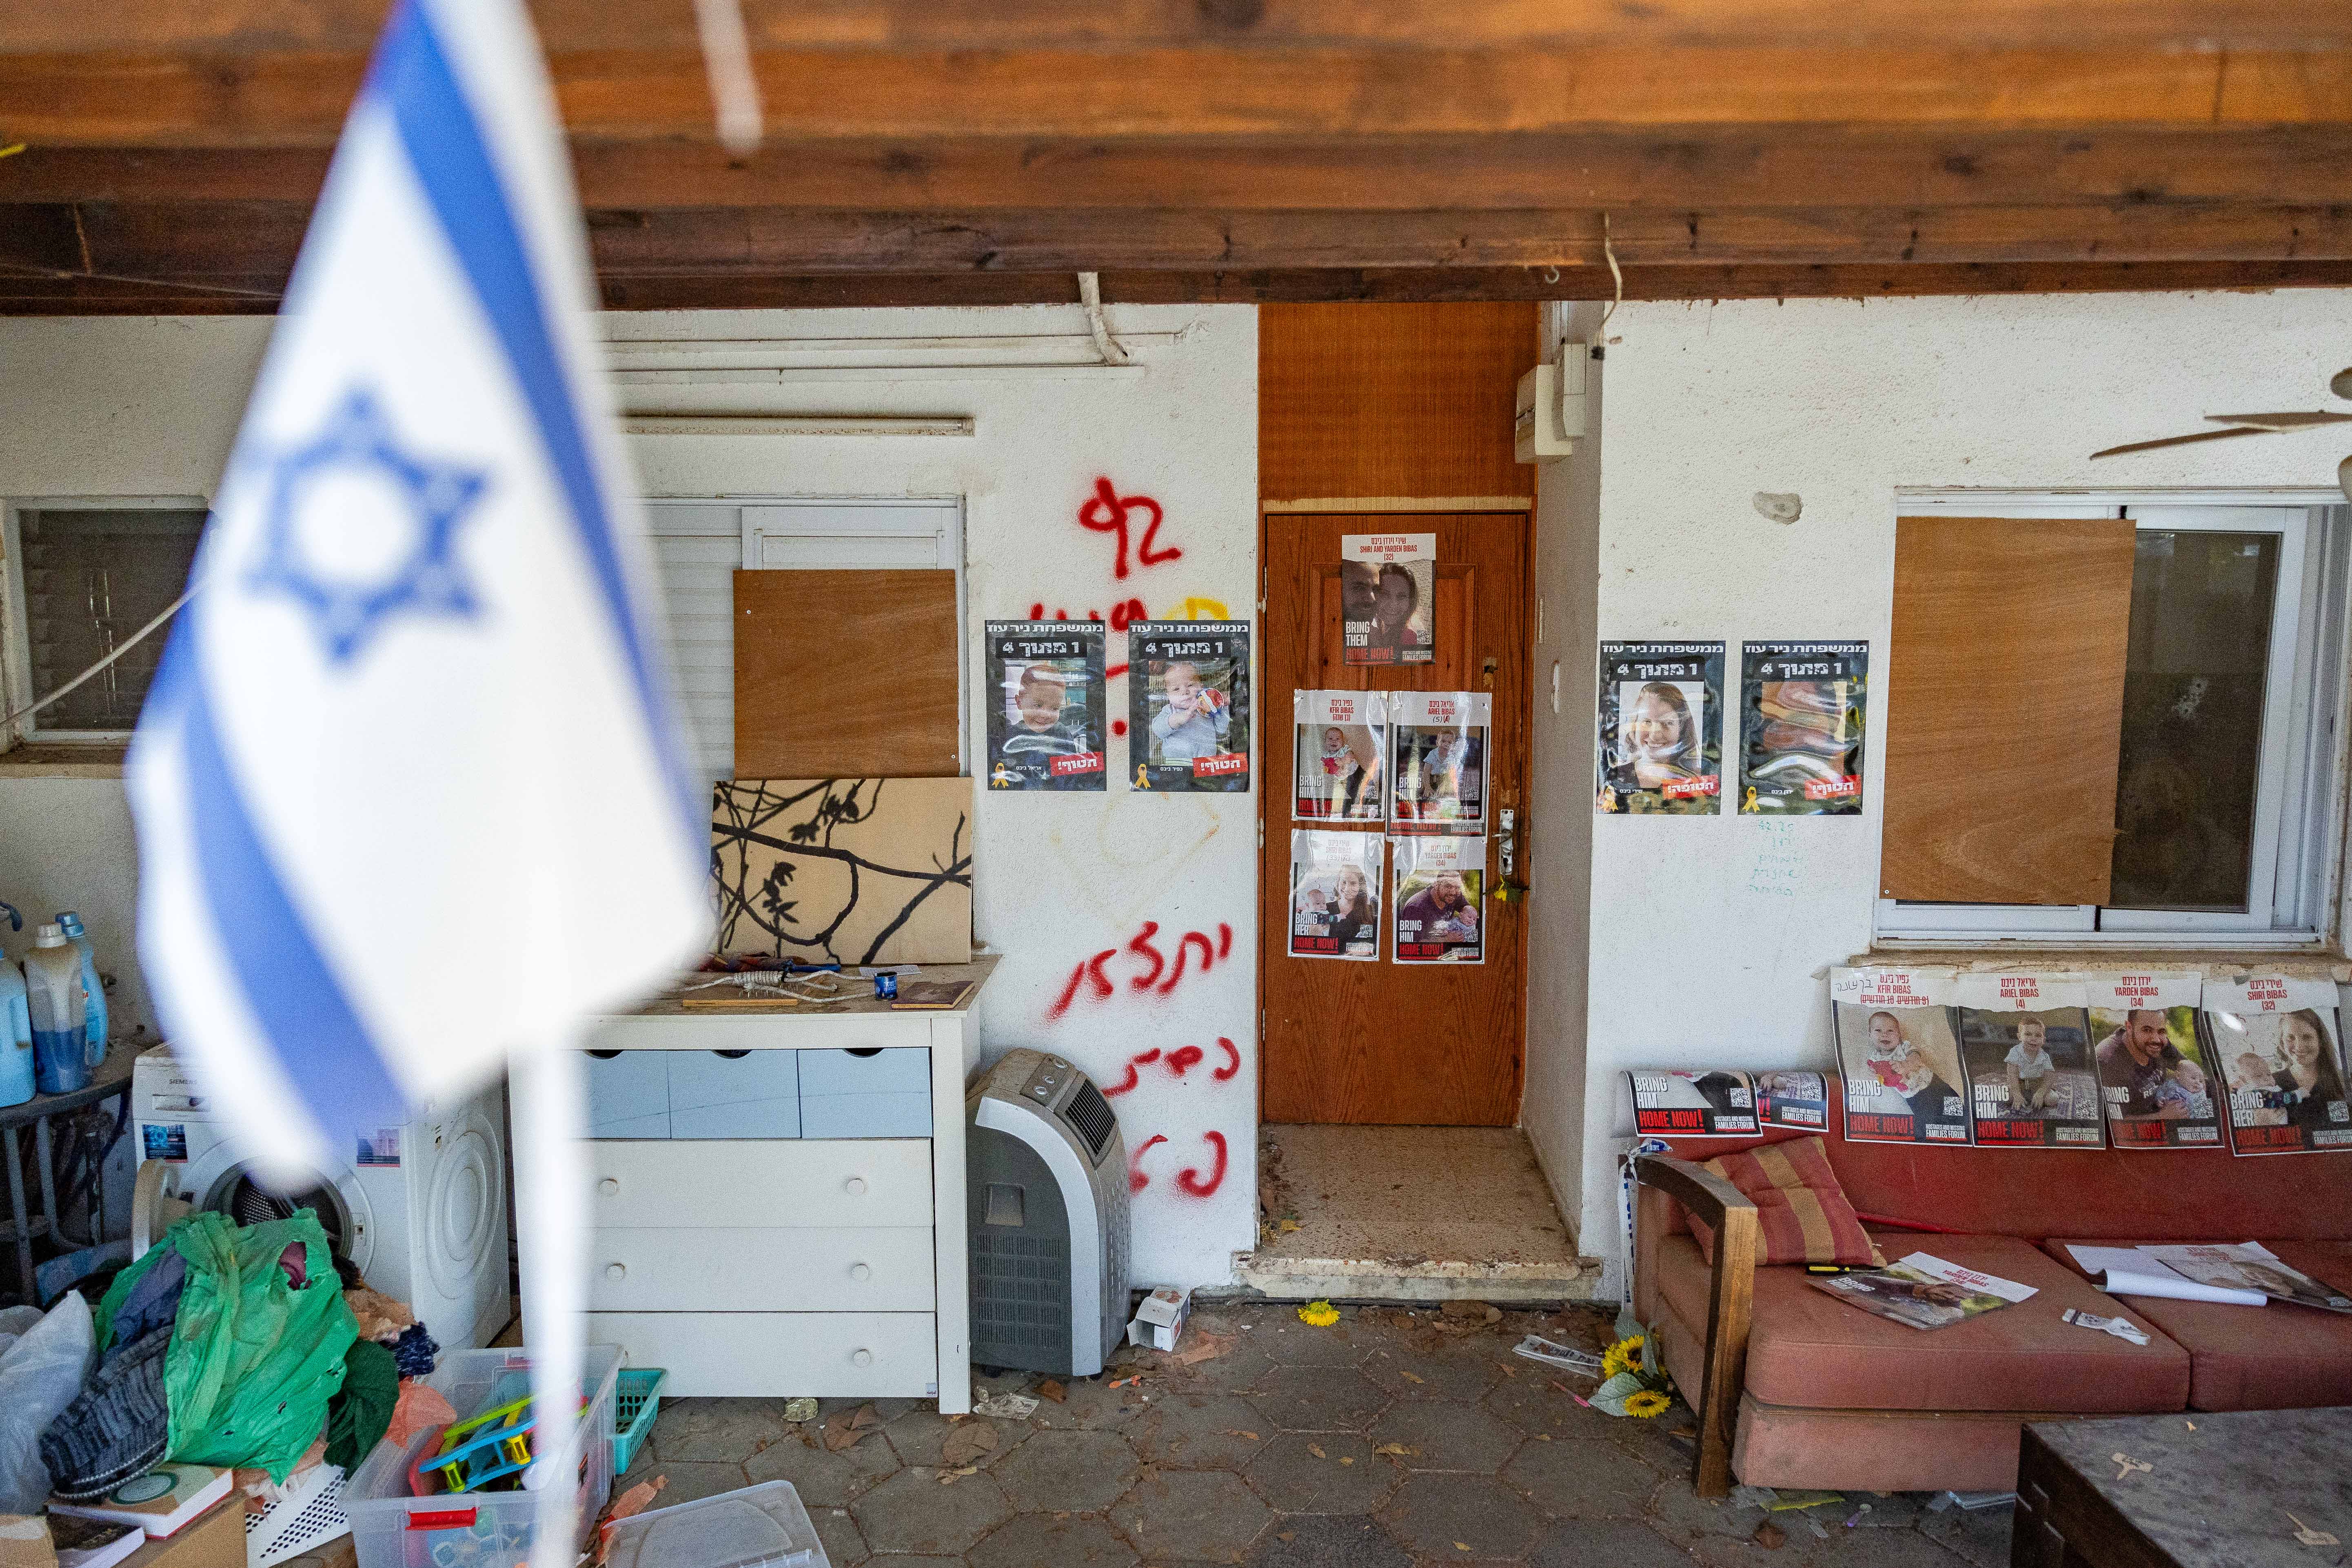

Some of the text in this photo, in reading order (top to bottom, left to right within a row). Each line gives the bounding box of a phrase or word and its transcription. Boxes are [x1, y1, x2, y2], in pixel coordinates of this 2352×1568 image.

[1384, 553, 1394, 561] (32)
[1346, 621, 1370, 633] BRING
[1346, 634, 1368, 646] THEM
[1003, 642, 1079, 657] 1 מתוך 4
[1145, 642, 1223, 657] 1 מתוך 4
[1617, 663, 1697, 679] 1 מתוך 4
[1761, 662, 1842, 679] 1 מתוך 4
[1300, 776, 1322, 787] BRING
[1399, 777, 1422, 788] BRING
[1299, 787, 1313, 798] HIM
[1296, 914, 1318, 925] BRING
[1295, 925, 1309, 936] HER
[1400, 920, 1422, 931] BRING
[1400, 932, 1413, 942] HIM
[1880, 974, 1909, 983] כפיר ביבס
[2001, 978, 2036, 987] אריאל ביבס
[2122, 976, 2151, 986] ירדן ביבס
[2250, 979, 2282, 989] שירי ביבס
[1835, 979, 1873, 993] בן שנה
[1877, 985, 1911, 994] KFIR BIBAS
[2115, 987, 2158, 996] YARDEN BIBAS
[2000, 989, 2039, 998] ARIEL BIBAS
[2248, 989, 2287, 1000] SHIRI BIBAS
[2016, 998, 2025, 1009] (4)
[2131, 998, 2143, 1007] (34)
[2262, 1000, 2275, 1011] (32)
[1634, 1077, 1668, 1092] BRING
[1849, 1080, 1881, 1096] BRING
[1975, 1085, 2009, 1101] BRING
[1637, 1093, 1658, 1108] HIM
[1849, 1096, 1870, 1113] HIM
[2230, 1092, 2264, 1110] BRING
[1976, 1102, 1997, 1118] HIM
[1639, 1109, 1704, 1127] HOME NOW!
[1782, 1112, 1821, 1123] FAMILIES FORUM
[2233, 1109, 2255, 1127] HER
[1926, 1129, 1966, 1139] FAMILIES FORUM
[1978, 1120, 2044, 1138] HOME NOW!
[2178, 1132, 2218, 1141] FAMILIES FORUM
[2314, 1136, 2336, 1144] FAMILIES
[1838, 1277, 1875, 1291] BRING
